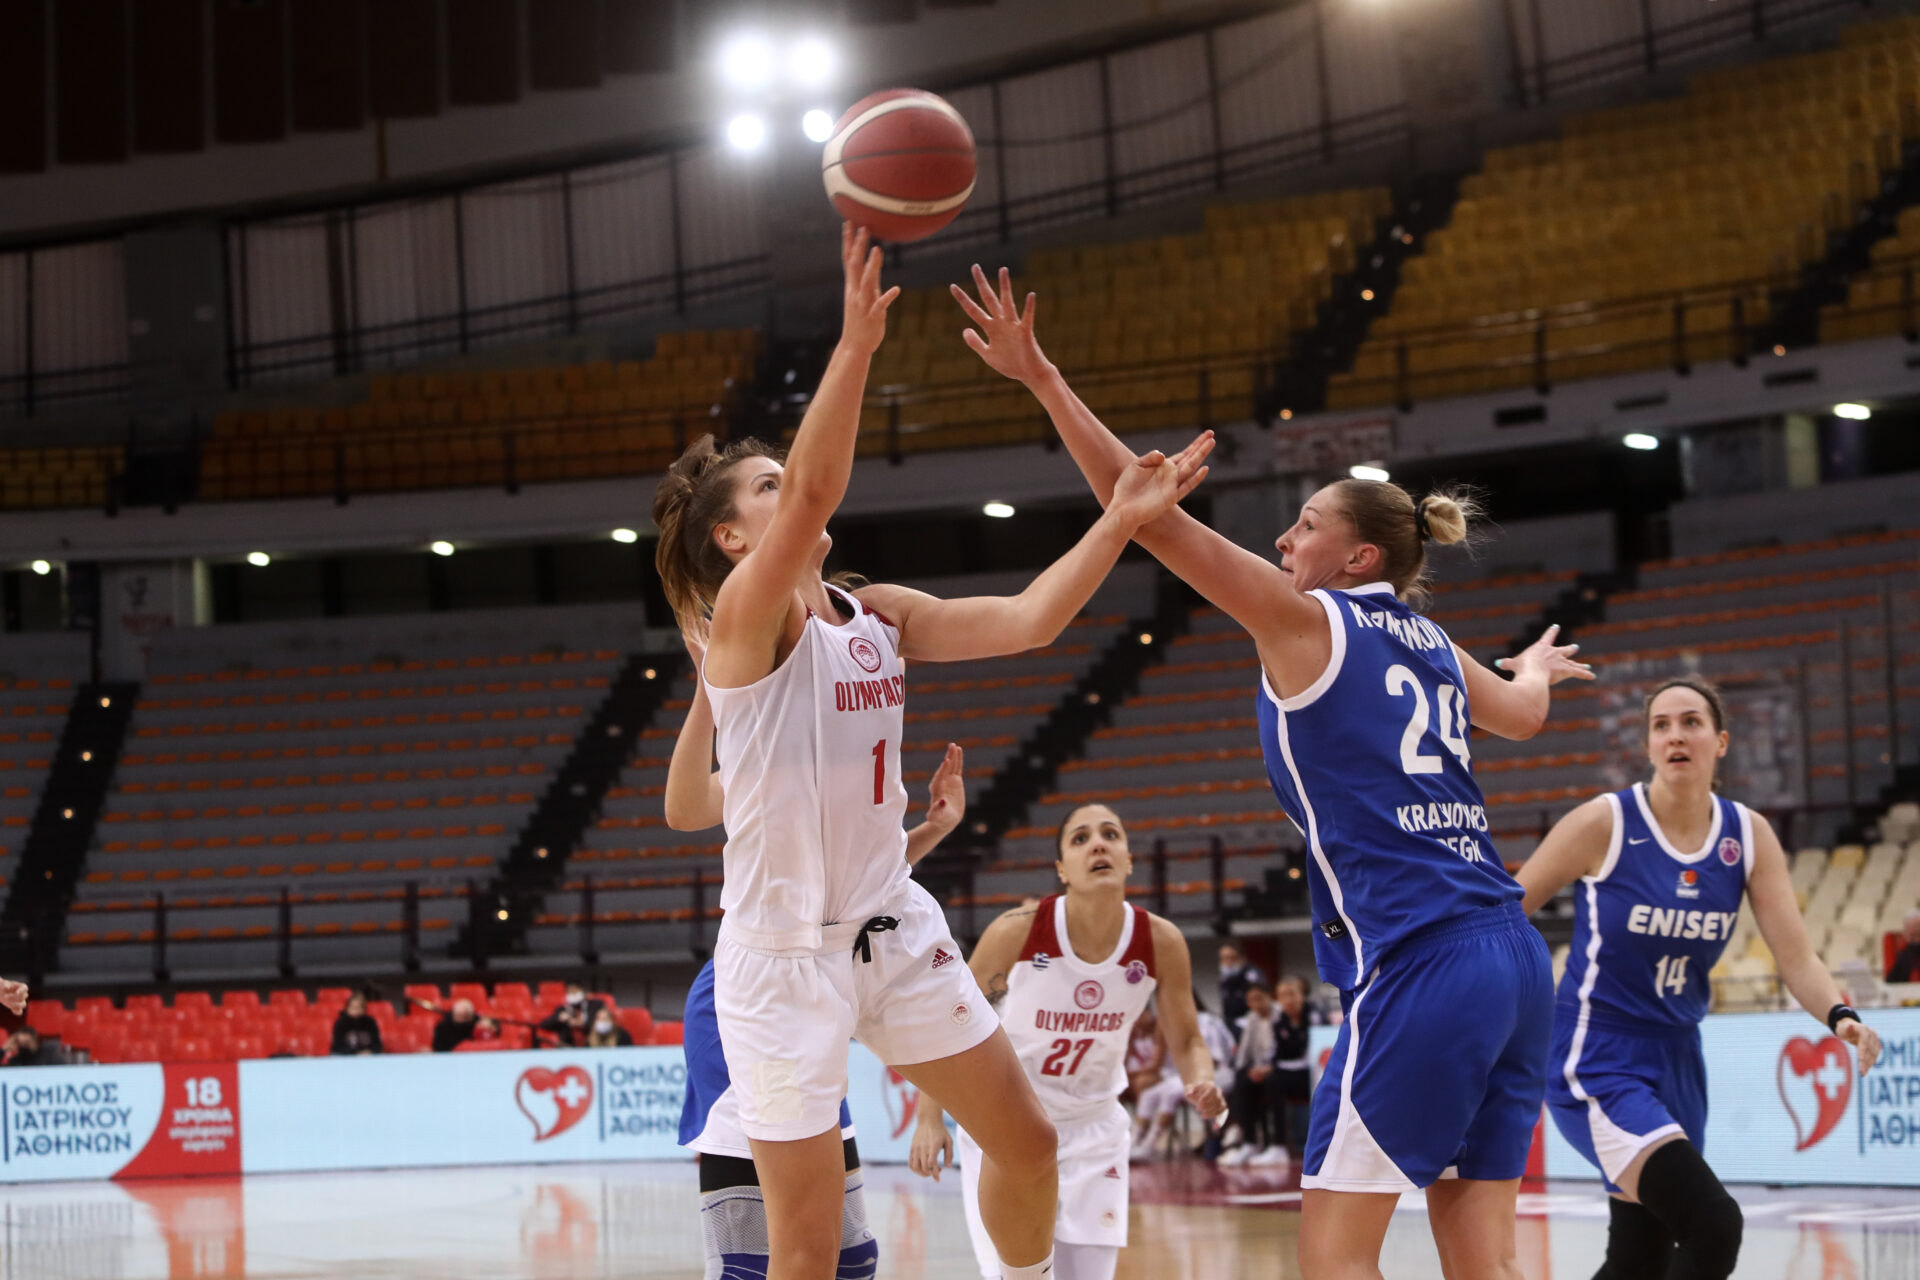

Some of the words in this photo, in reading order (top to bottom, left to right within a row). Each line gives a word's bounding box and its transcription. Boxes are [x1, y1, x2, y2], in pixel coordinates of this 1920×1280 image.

[1385, 664, 1471, 774] 24
[871, 738, 887, 805] 1
[1329, 924, 1342, 935] XL
[1627, 904, 1737, 941] ENISEY
[932, 954, 954, 970] adidas
[1655, 955, 1690, 999] 14
[1035, 1009, 1125, 1033] OLYMPIACOS
[1041, 1038, 1095, 1077] 27
[608, 1064, 687, 1088] ΟΜΙΛΟ
[13, 1083, 117, 1106] ΟΜΙΛΟΣ
[184, 1077, 222, 1107] 18
[609, 1089, 685, 1110] ΙΑΤΡΙΚ
[1869, 1075, 1920, 1107] ΙΑΤΡ
[15, 1106, 132, 1130] ΙΑΤΡΙΚΟΥ
[610, 1114, 680, 1136] ΑΘΗΝ
[1869, 1113, 1920, 1145] ΑΘΗ
[15, 1132, 131, 1156] ΑΘΗΝΩΝ
